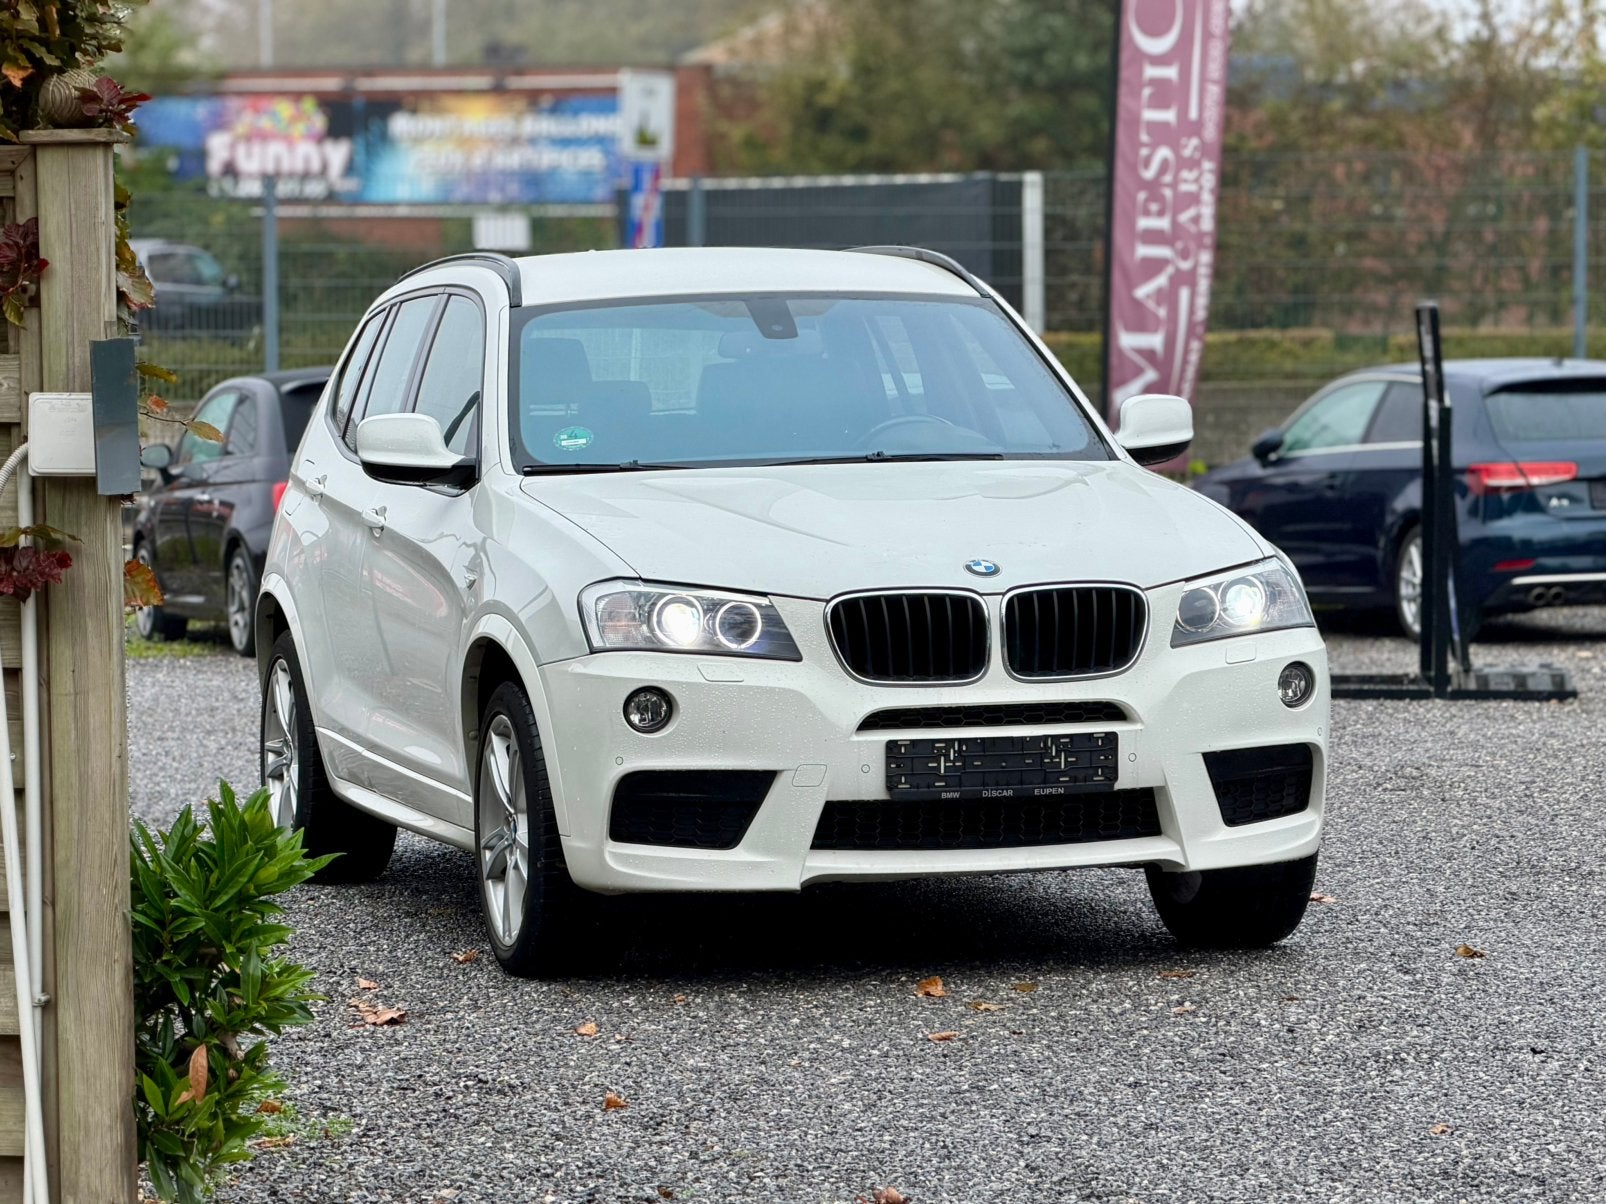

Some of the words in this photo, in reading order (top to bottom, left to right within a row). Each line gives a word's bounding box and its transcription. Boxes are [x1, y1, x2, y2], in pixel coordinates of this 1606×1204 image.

[206, 130, 353, 187] Funny
[1173, 137, 1202, 271] CARS
[1111, 0, 1184, 416] MAJESTIC
[1034, 787, 1065, 796] EUPEN
